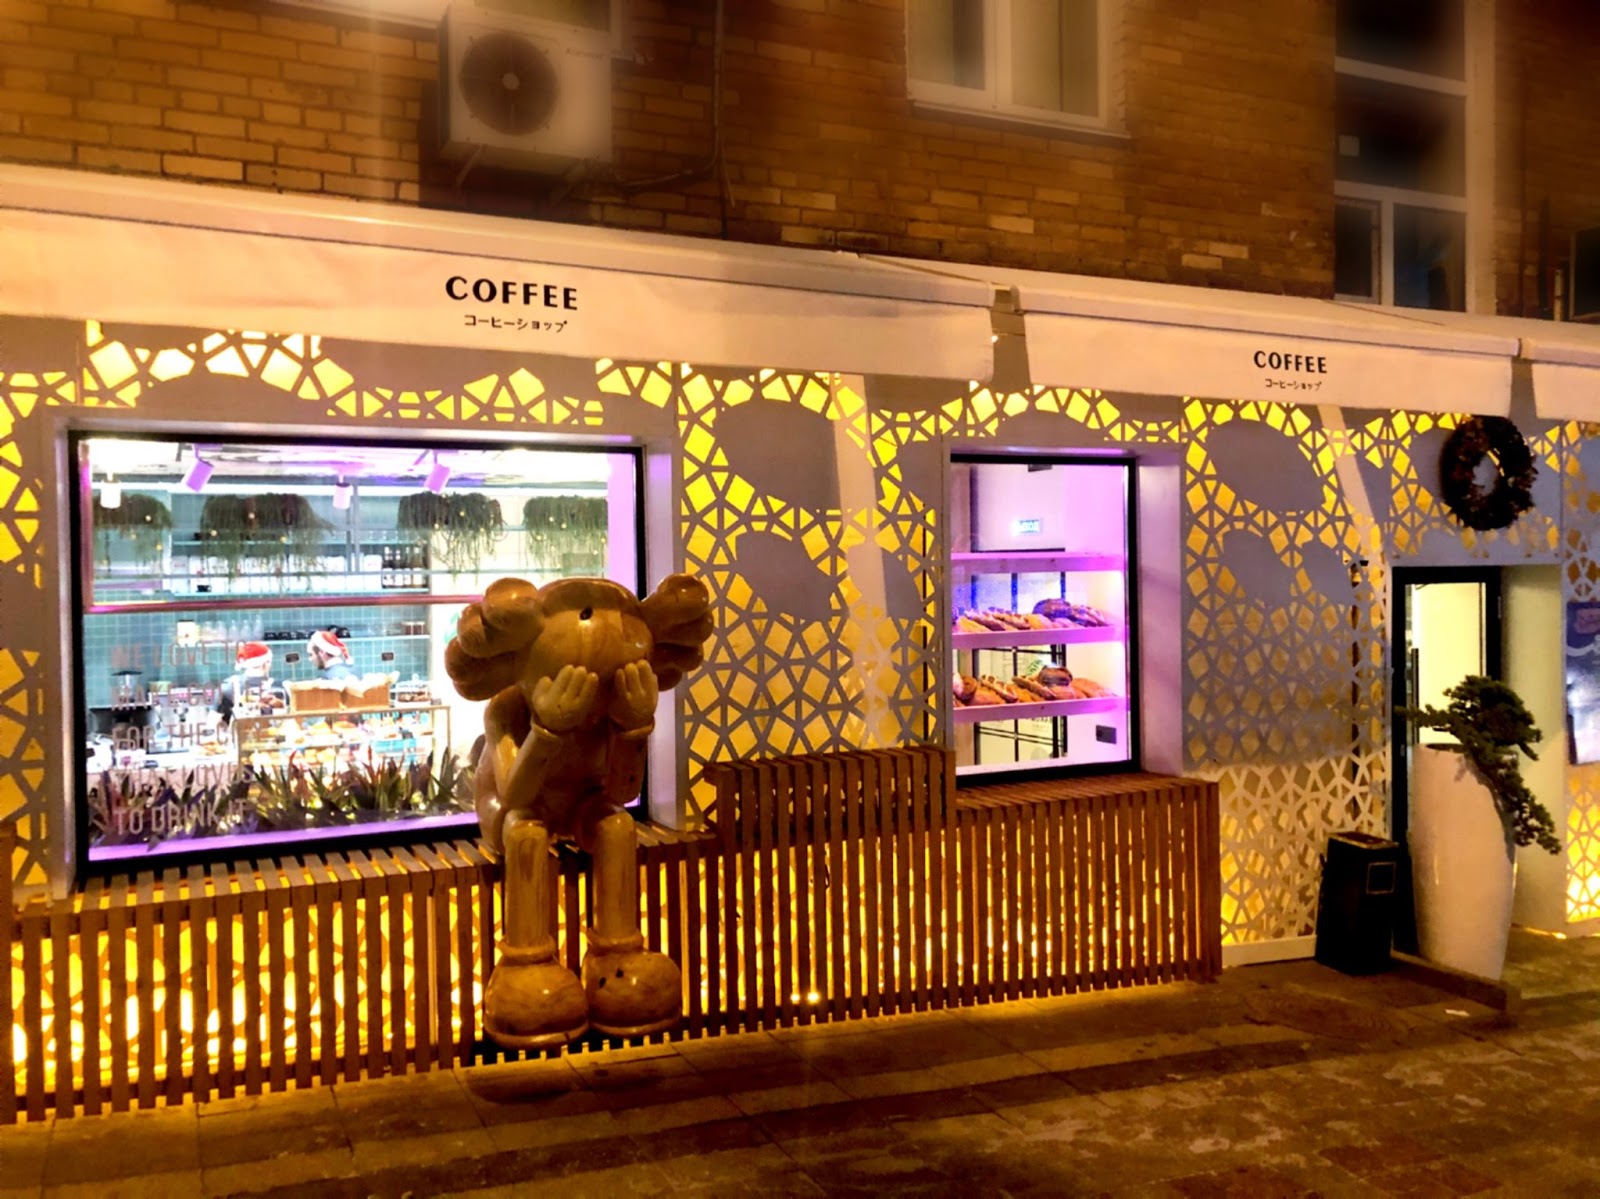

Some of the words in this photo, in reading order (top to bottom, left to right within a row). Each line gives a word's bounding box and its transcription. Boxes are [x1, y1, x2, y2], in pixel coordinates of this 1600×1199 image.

[445, 275, 578, 310] COFFEE
[464, 315, 567, 333] コーヒーショップ
[1253, 350, 1327, 373] COFFEE
[165, 721, 207, 748] THE
[113, 808, 143, 836] TO
[151, 799, 219, 833] DRINK
